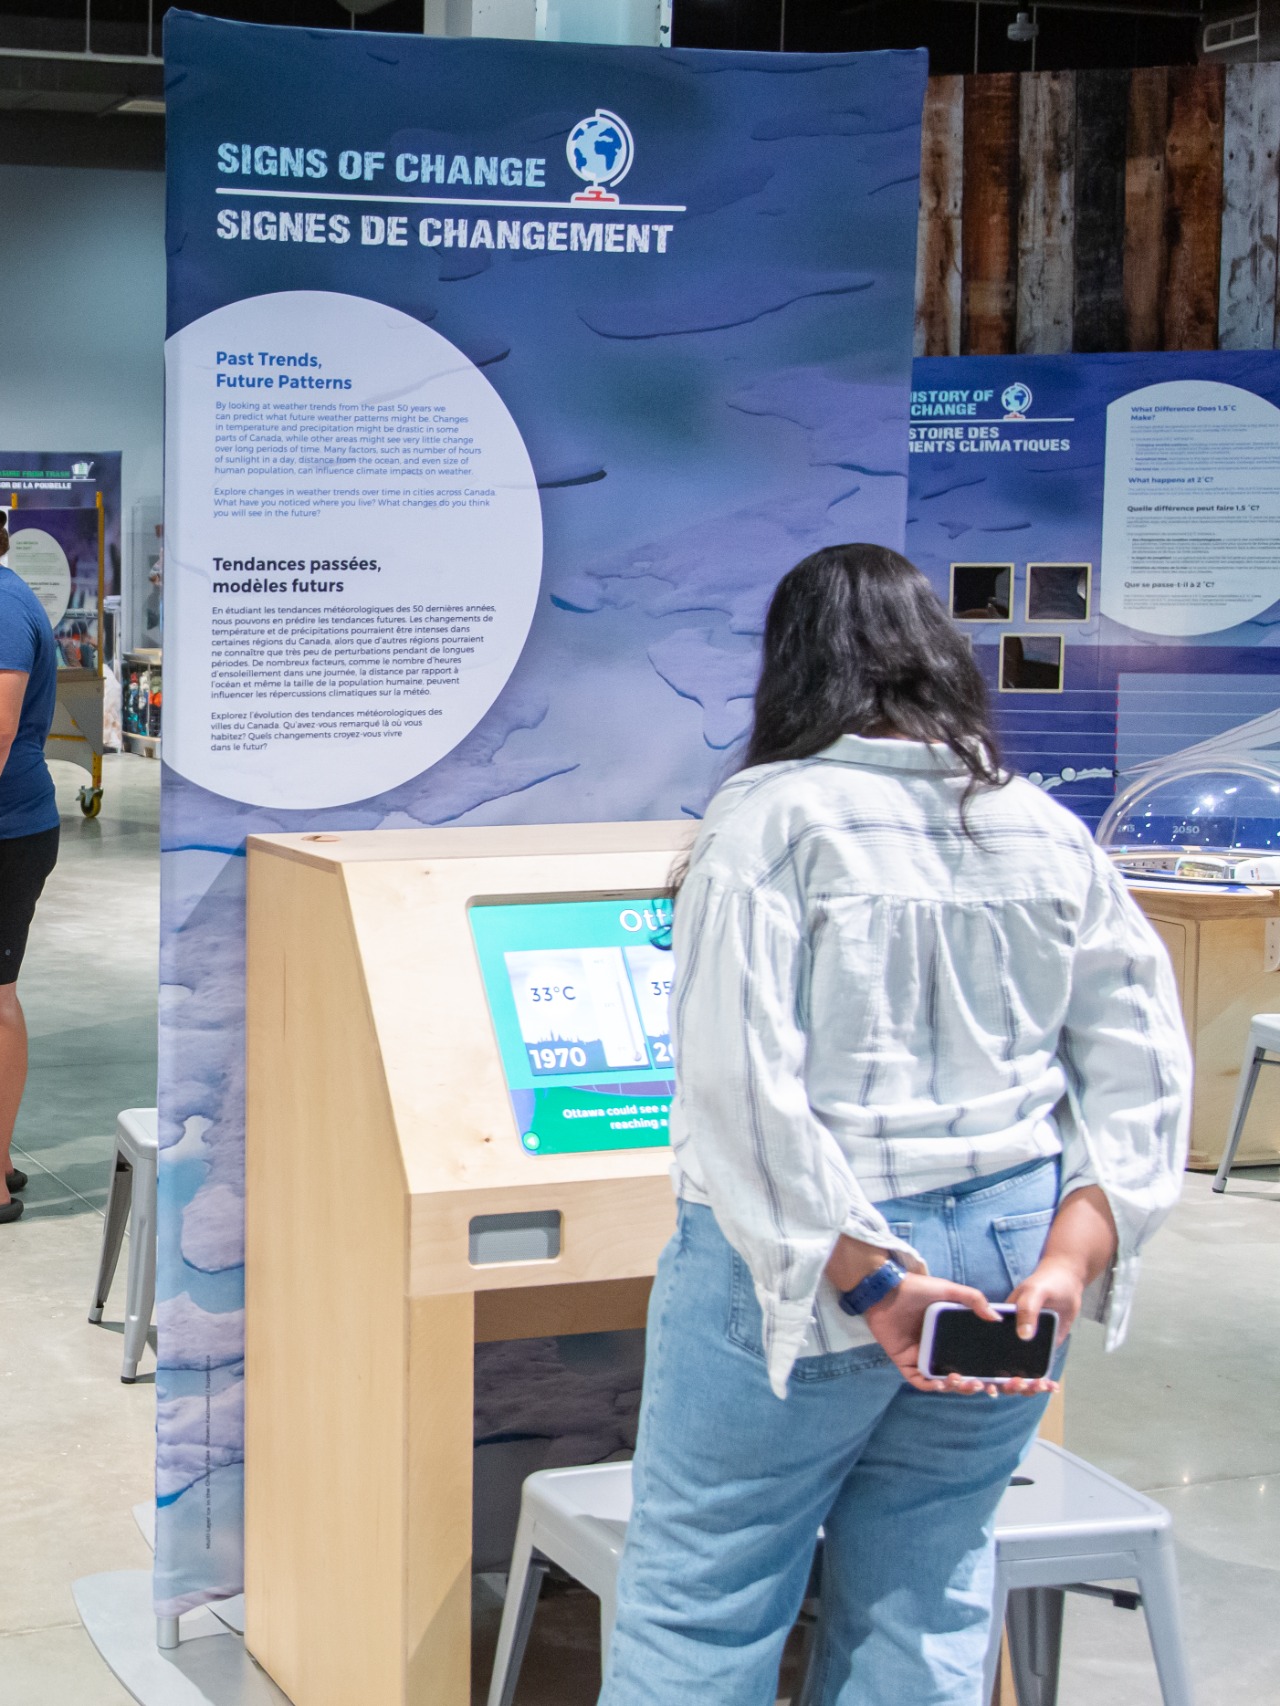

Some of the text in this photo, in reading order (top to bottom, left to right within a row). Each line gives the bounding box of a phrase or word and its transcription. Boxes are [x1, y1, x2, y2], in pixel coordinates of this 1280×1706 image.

[217, 143, 546, 187] SIGNS OF CHANGE
[216, 209, 674, 252] SIGNES DE CHANGEMENT
[216, 350, 322, 368] Past Trends,
[216, 373, 352, 389] Future Patterns
[973, 390, 994, 402] OF
[215, 401, 226, 411] By
[228, 401, 260, 411] looking
[272, 402, 308, 410] weather
[338, 402, 359, 411] from
[360, 402, 375, 411] the
[376, 404, 395, 413] past
[396, 403, 408, 412] 50
[410, 405, 432, 413] years
[911, 404, 976, 416] CHANGE
[232, 412, 264, 421] predict
[289, 412, 315, 421] future
[353, 414, 388, 423] patterns
[390, 414, 416, 424] might
[418, 414, 430, 422] be.
[432, 414, 469, 424] Changes
[225, 424, 279, 432] temperature
[280, 423, 298, 432] and
[299, 424, 354, 433] precipitation
[356, 424, 381, 434] might
[383, 424, 394, 433] be
[395, 424, 424, 433] drastic
[909, 427, 999, 439] STOIRE DES
[960, 439, 1070, 452] CLIMATIQUES
[212, 556, 381, 574] Tendances passées,
[212, 578, 344, 593] modèles futurs
[211, 606, 223, 615] En
[224, 606, 261, 614] étudiant
[263, 606, 276, 614] les
[323, 605, 394, 614] météorologiques
[395, 605, 410, 613] des
[412, 604, 424, 613] 50
[425, 604, 464, 612] dernières
[465, 604, 496, 612] années,
[285, 616, 316, 625] prédire
[376, 615, 407, 623] futures.
[409, 615, 423, 623] Les
[424, 615, 481, 624] changements
[482, 614, 493, 622] de
[1173, 826, 1200, 834] 2050
[620, 909, 671, 932] Ott
[530, 986, 576, 1002] 33°C
[529, 1047, 586, 1069] 1970
[562, 1108, 605, 1118] Ottawa
[606, 1105, 638, 1115] could
[639, 1105, 659, 1114] see
[610, 1118, 660, 1129] reaching
